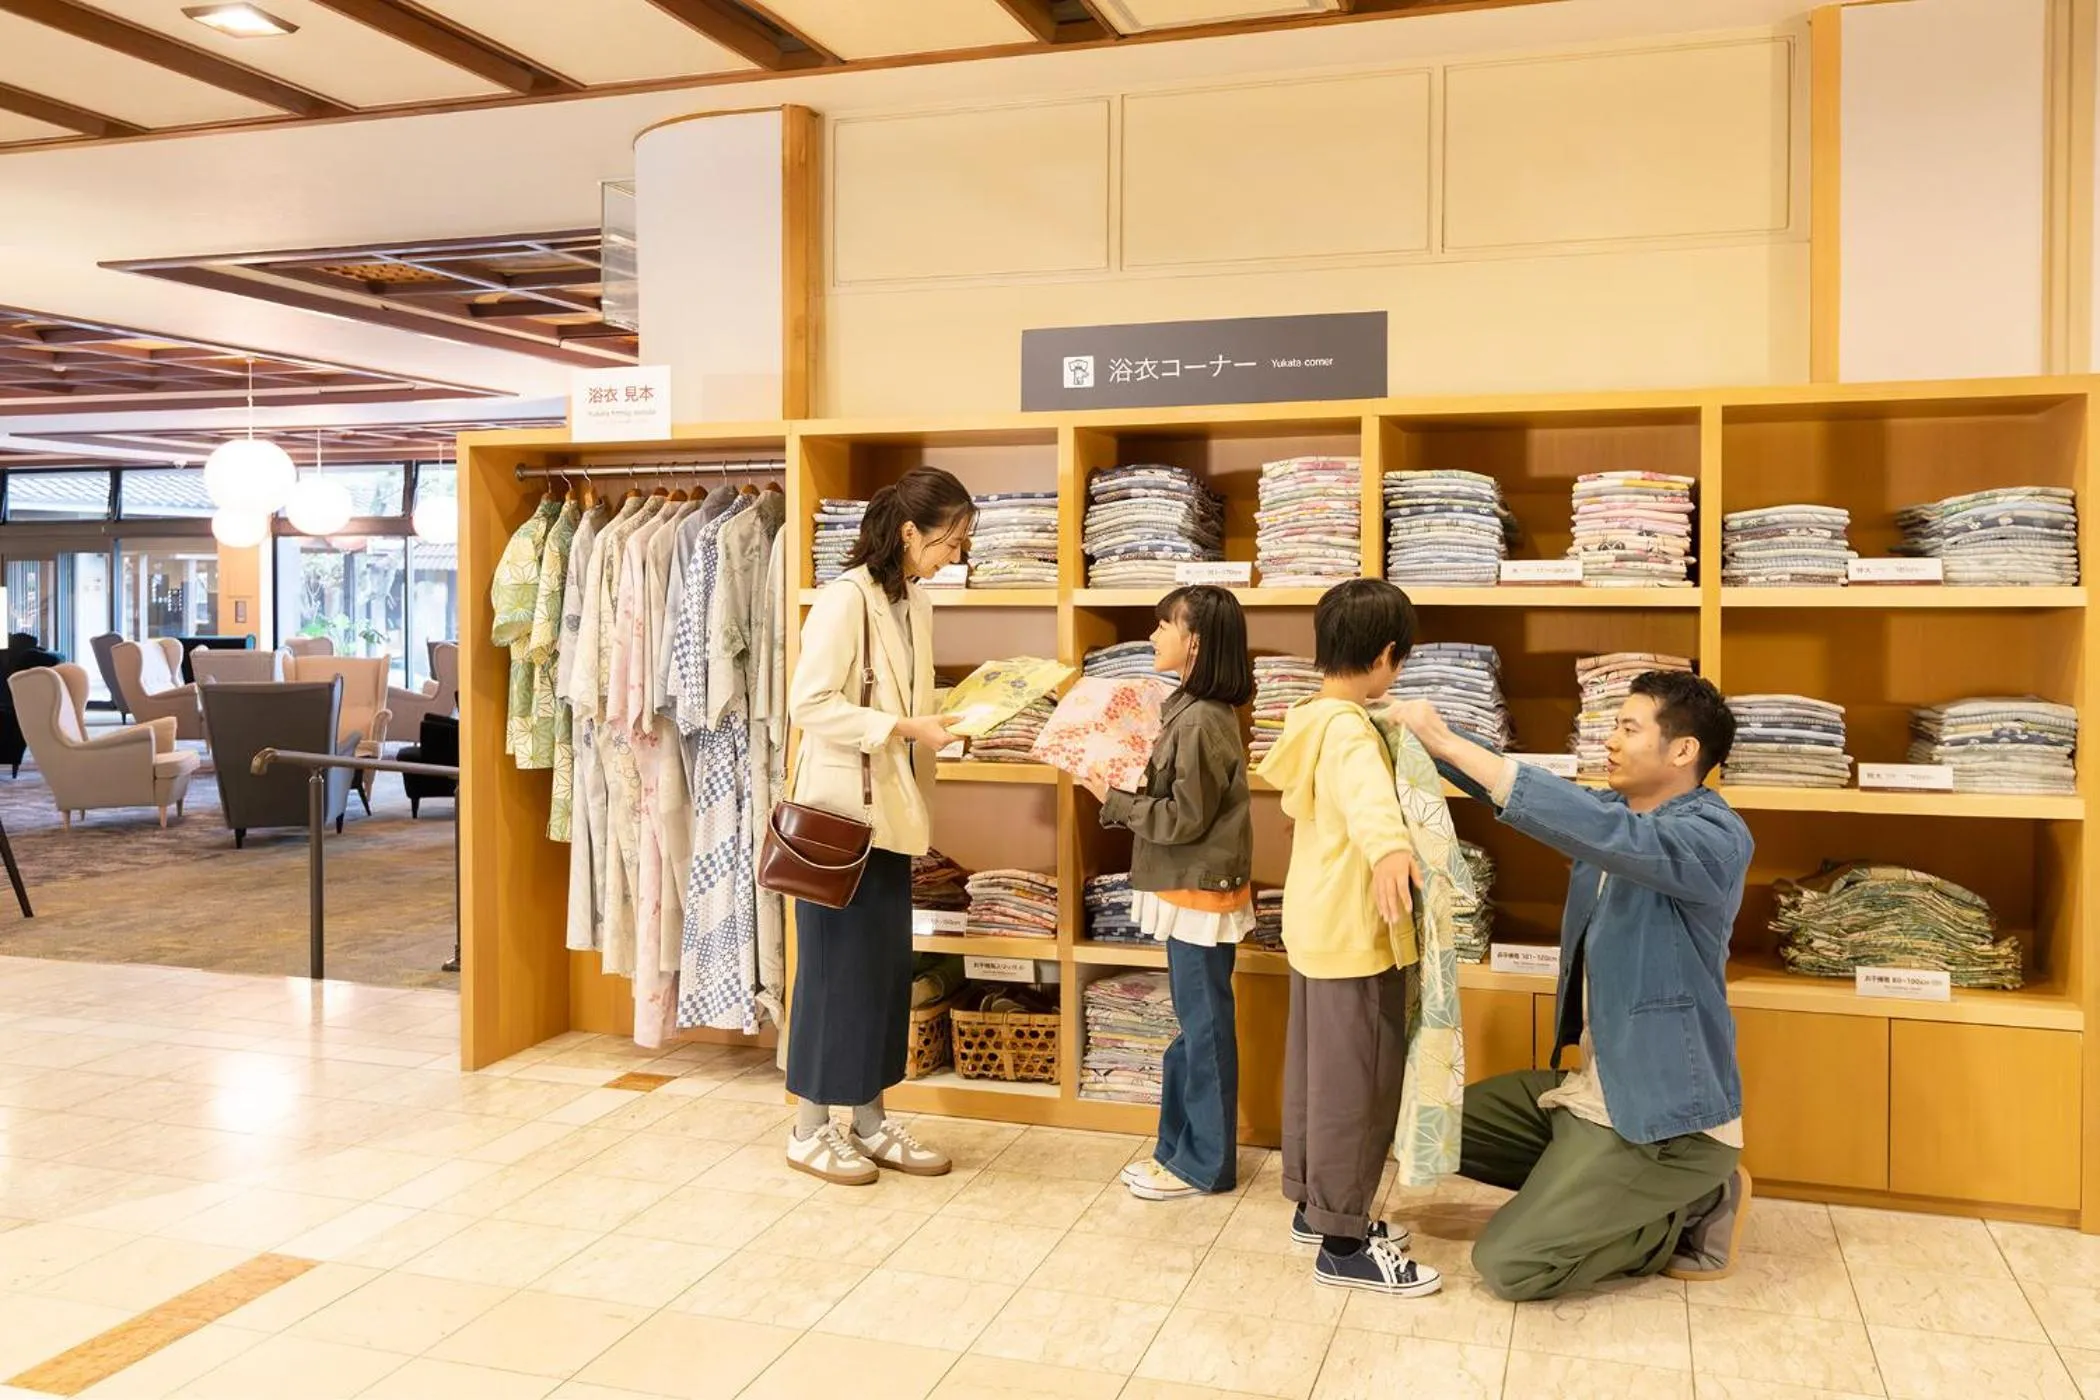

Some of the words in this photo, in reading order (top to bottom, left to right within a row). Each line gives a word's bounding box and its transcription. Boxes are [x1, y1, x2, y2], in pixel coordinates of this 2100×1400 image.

[1107, 354, 1257, 383] 浴衣コーナー
[1271, 358, 1301, 369] Yukata
[1304, 357, 1334, 368] corner
[588, 385, 618, 403] 浴衣
[624, 384, 656, 403] 見本
